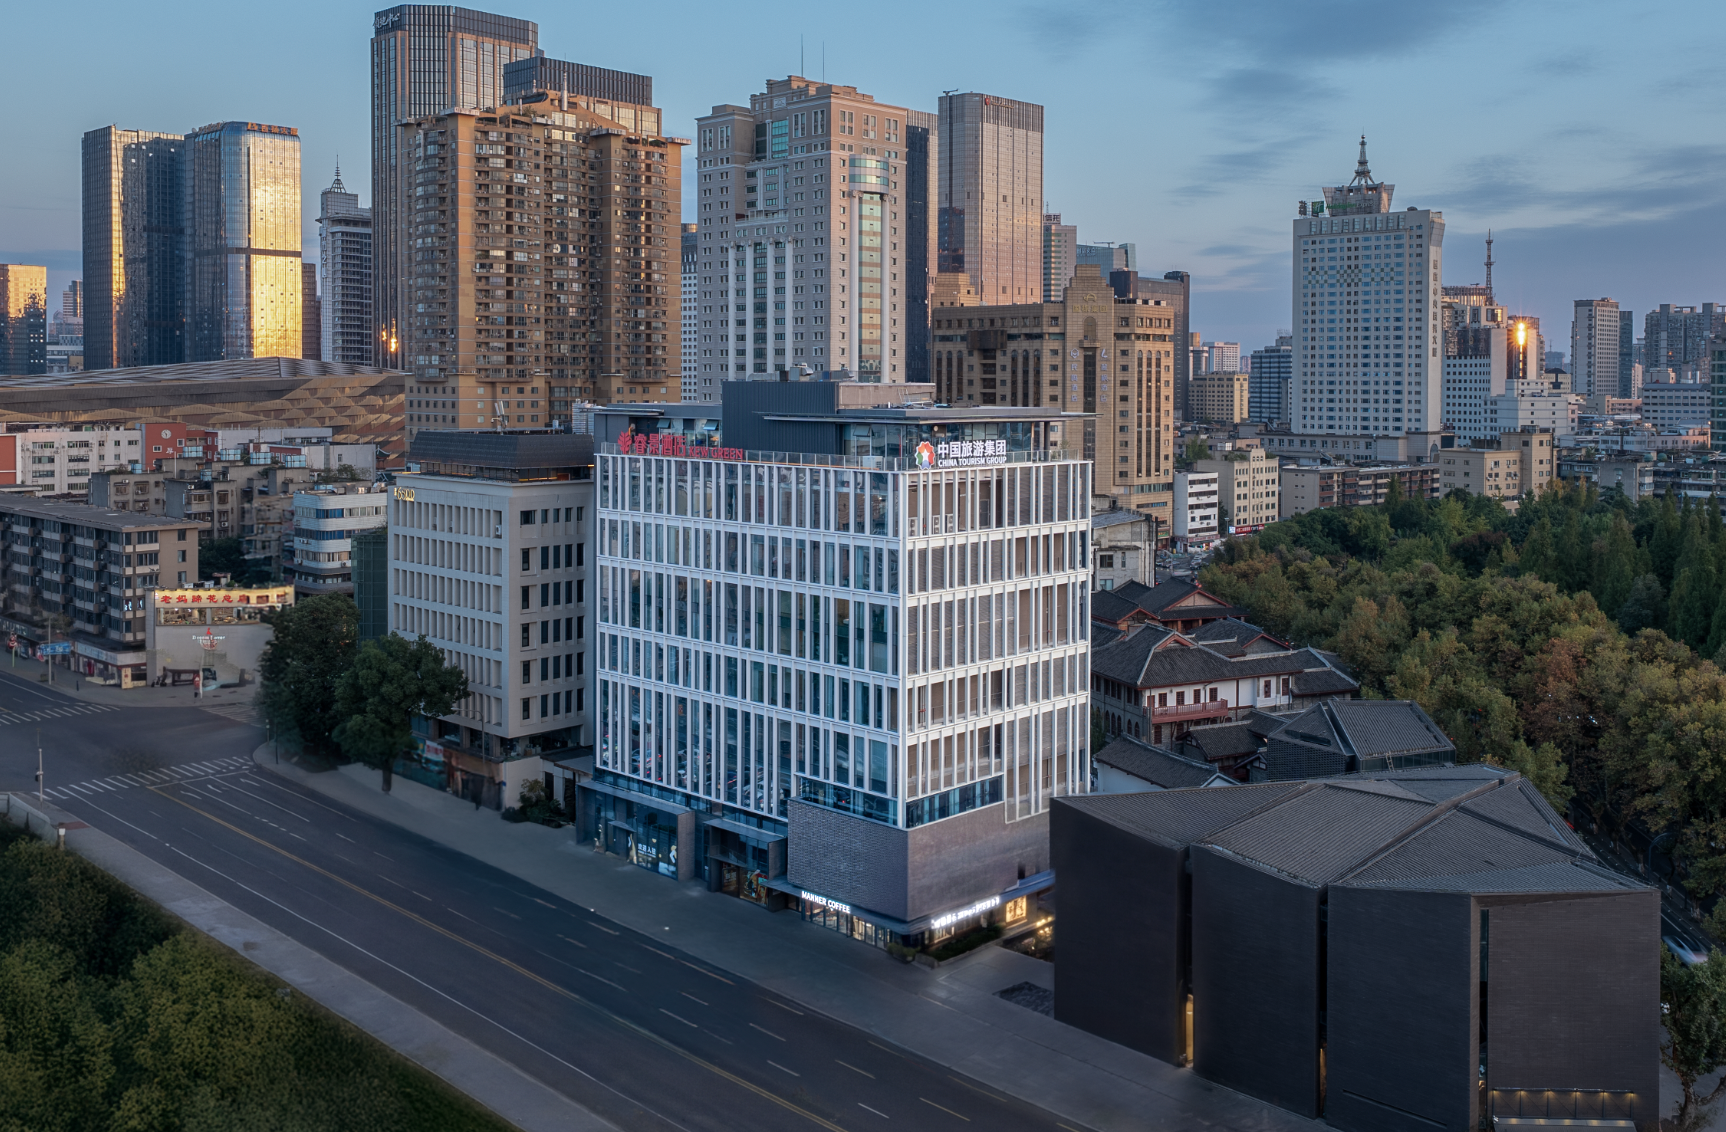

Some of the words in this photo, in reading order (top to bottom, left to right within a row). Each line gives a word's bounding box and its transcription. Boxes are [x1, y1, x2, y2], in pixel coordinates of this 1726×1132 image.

[634, 433, 687, 457] 睿景酒店
[689, 446, 709, 458] KEW
[711, 447, 743, 460] GREEN
[938, 440, 1006, 458] 中国旅游集团
[938, 459, 958, 467] CHINA
[959, 457, 985, 466] TOURISM
[986, 456, 1007, 465] GROUP
[801, 890, 826, 906] MANNER
[828, 900, 851, 914] COFFEE
